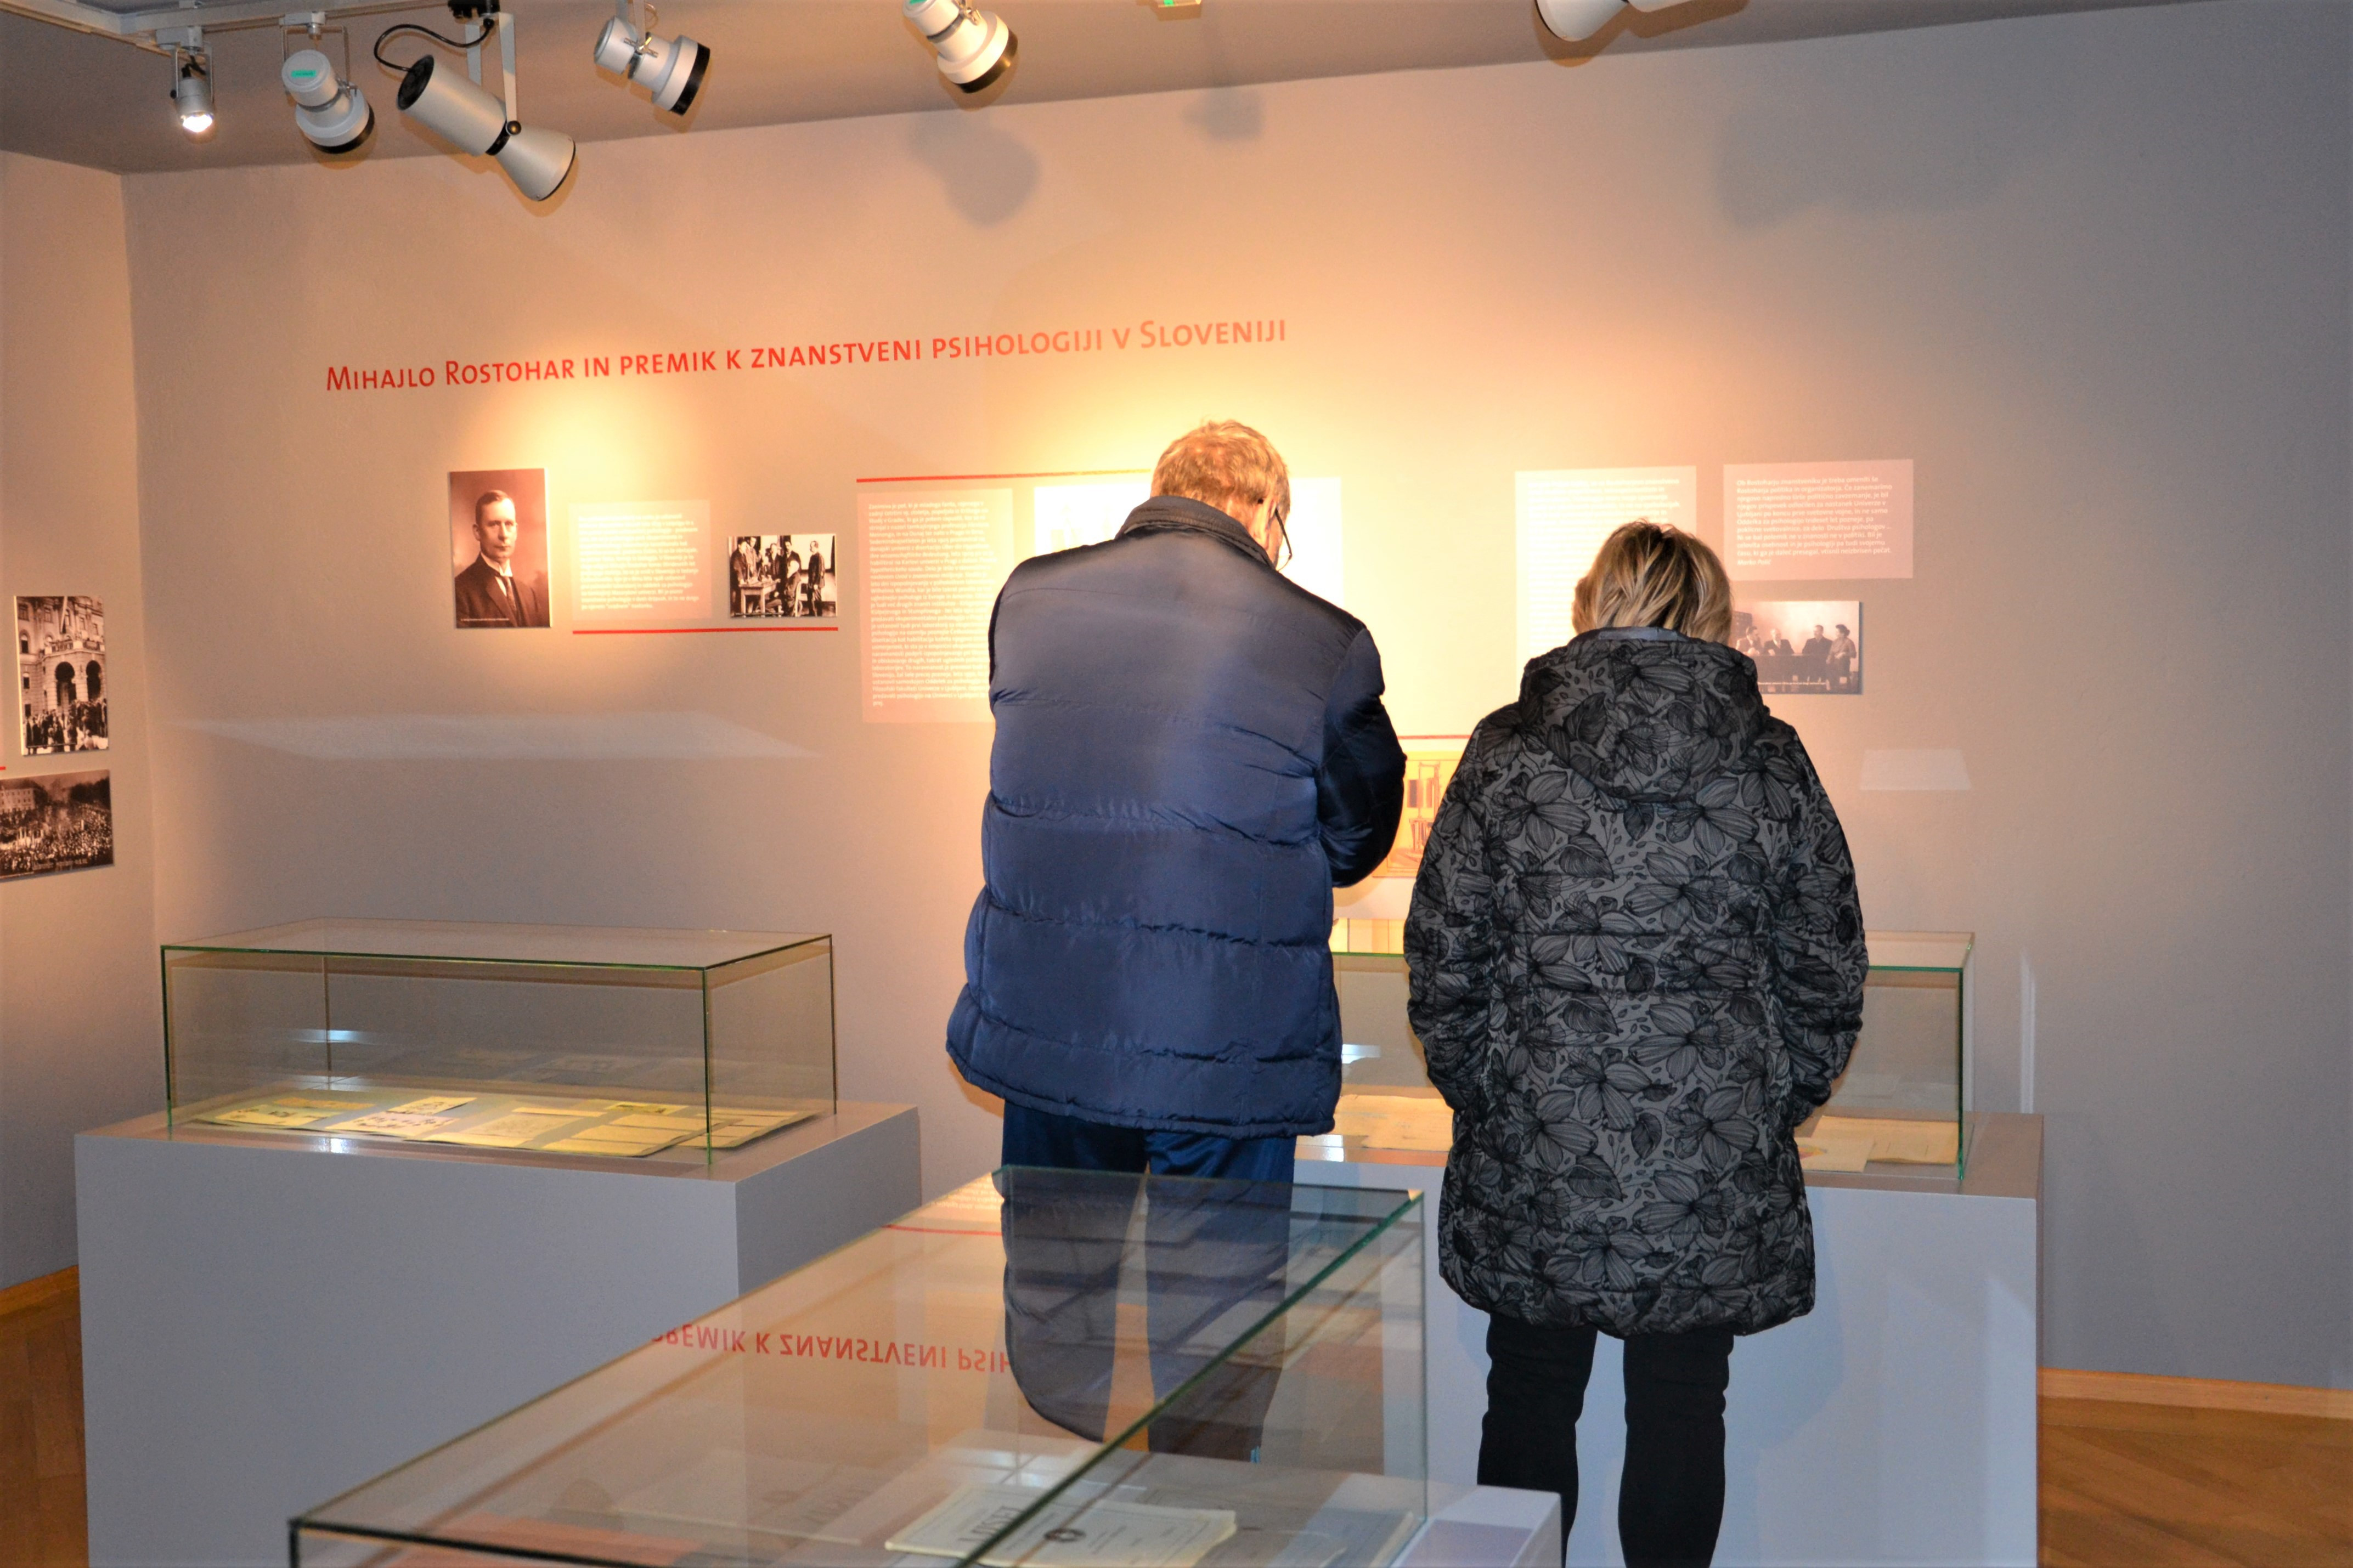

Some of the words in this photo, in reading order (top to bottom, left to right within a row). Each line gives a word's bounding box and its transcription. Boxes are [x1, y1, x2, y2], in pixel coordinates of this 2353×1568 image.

[326, 366, 435, 390] MIHAJLO
[445, 360, 575, 385] ROSTOHAR
[584, 356, 610, 378] IN
[620, 350, 718, 376] PREMIK
[726, 349, 742, 370] K
[751, 339, 922, 369] ZNANSTVENI
[932, 330, 1102, 359] PSIHOLOGIJI
[1112, 328, 1131, 349] V
[1141, 320, 1285, 347] SLOVENIJI
